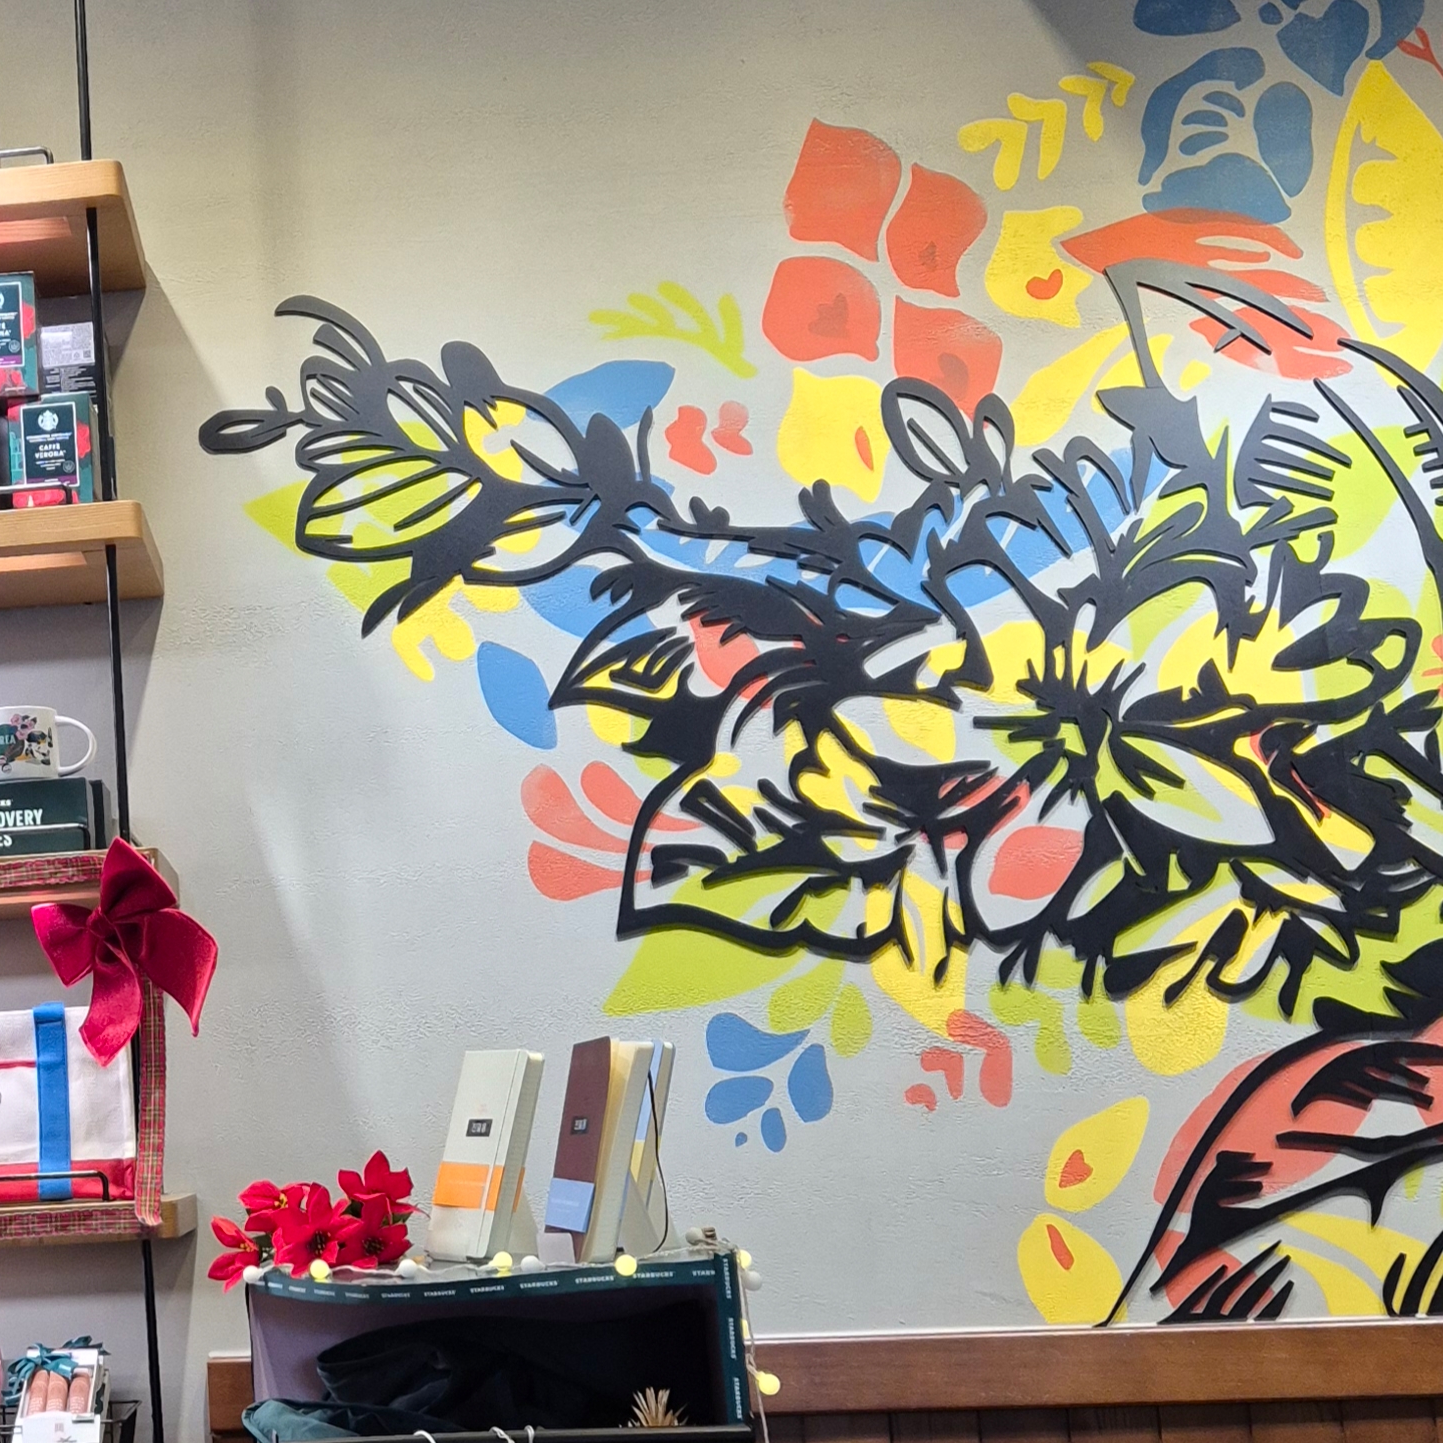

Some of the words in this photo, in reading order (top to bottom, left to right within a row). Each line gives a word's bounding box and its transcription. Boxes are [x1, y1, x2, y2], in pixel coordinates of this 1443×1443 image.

[469, 1285, 505, 1294] STARBUCKS
[519, 1280, 559, 1290] STARBUCKS
[575, 1274, 616, 1284] STARBUCKS
[632, 1270, 674, 1279] STARBUCKS
[692, 1269, 716, 1277] STARB
[723, 1258, 732, 1299] STARBUCKS
[728, 1317, 737, 1360] STARBUCKS
[733, 1377, 743, 1419] STARBUCKS
